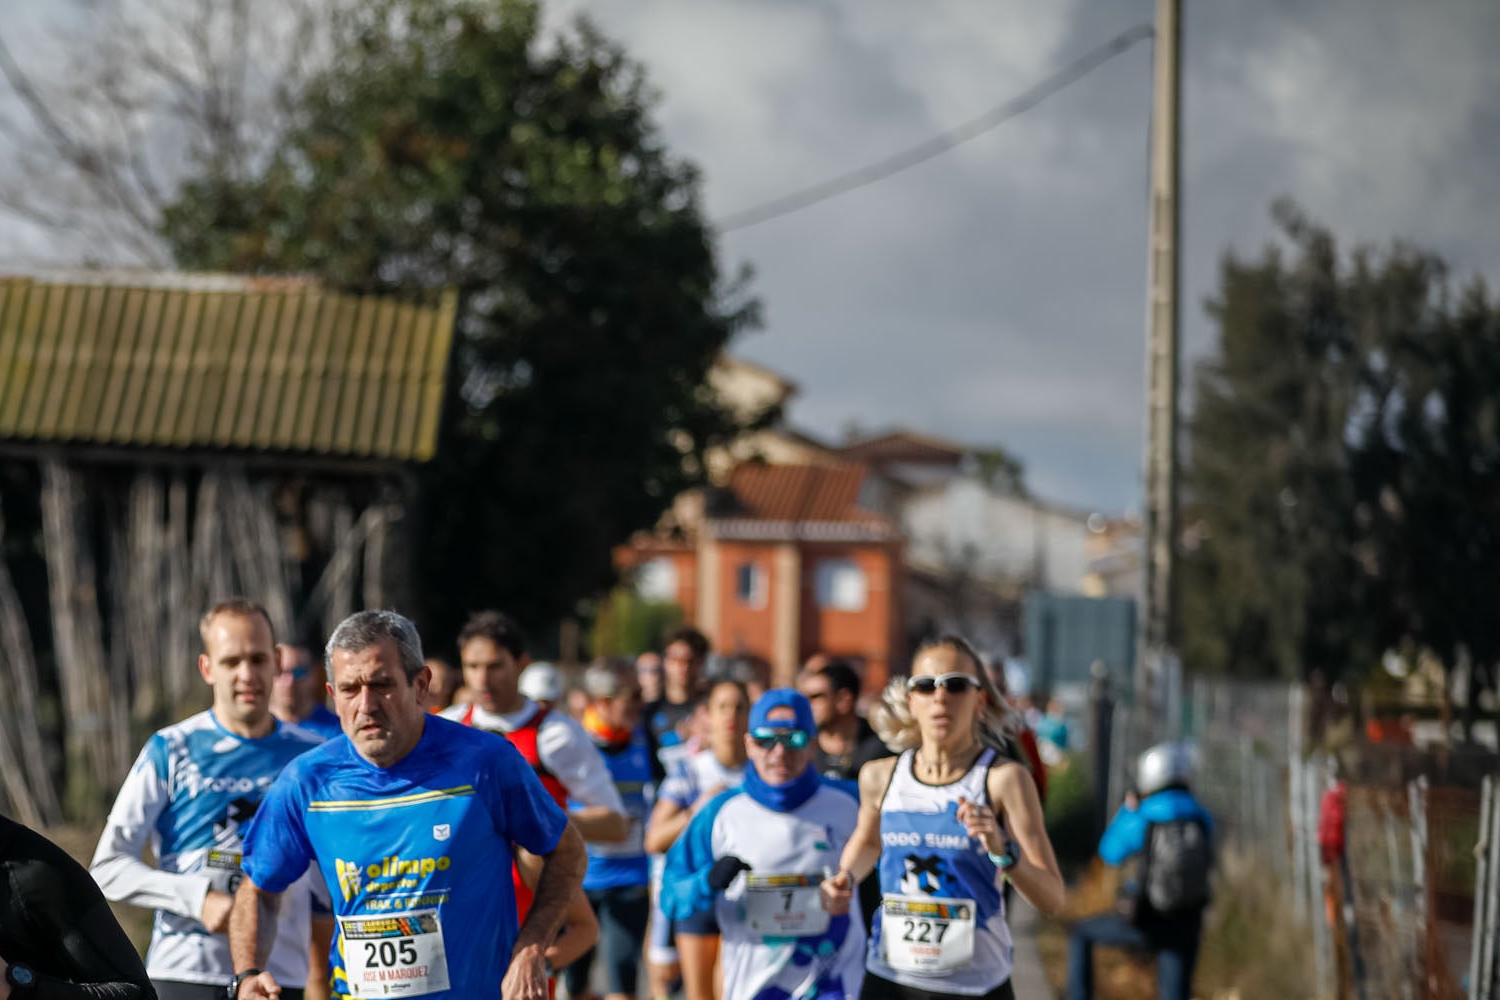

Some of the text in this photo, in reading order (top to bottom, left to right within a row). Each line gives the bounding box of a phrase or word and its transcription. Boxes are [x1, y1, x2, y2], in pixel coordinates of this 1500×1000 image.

[366, 855, 450, 878] olimpo
[366, 879, 418, 892] deportes
[781, 890, 793, 911] 7
[903, 920, 950, 943] 227
[364, 939, 417, 968] 205
[387, 965, 429, 980] MARQUEZ
